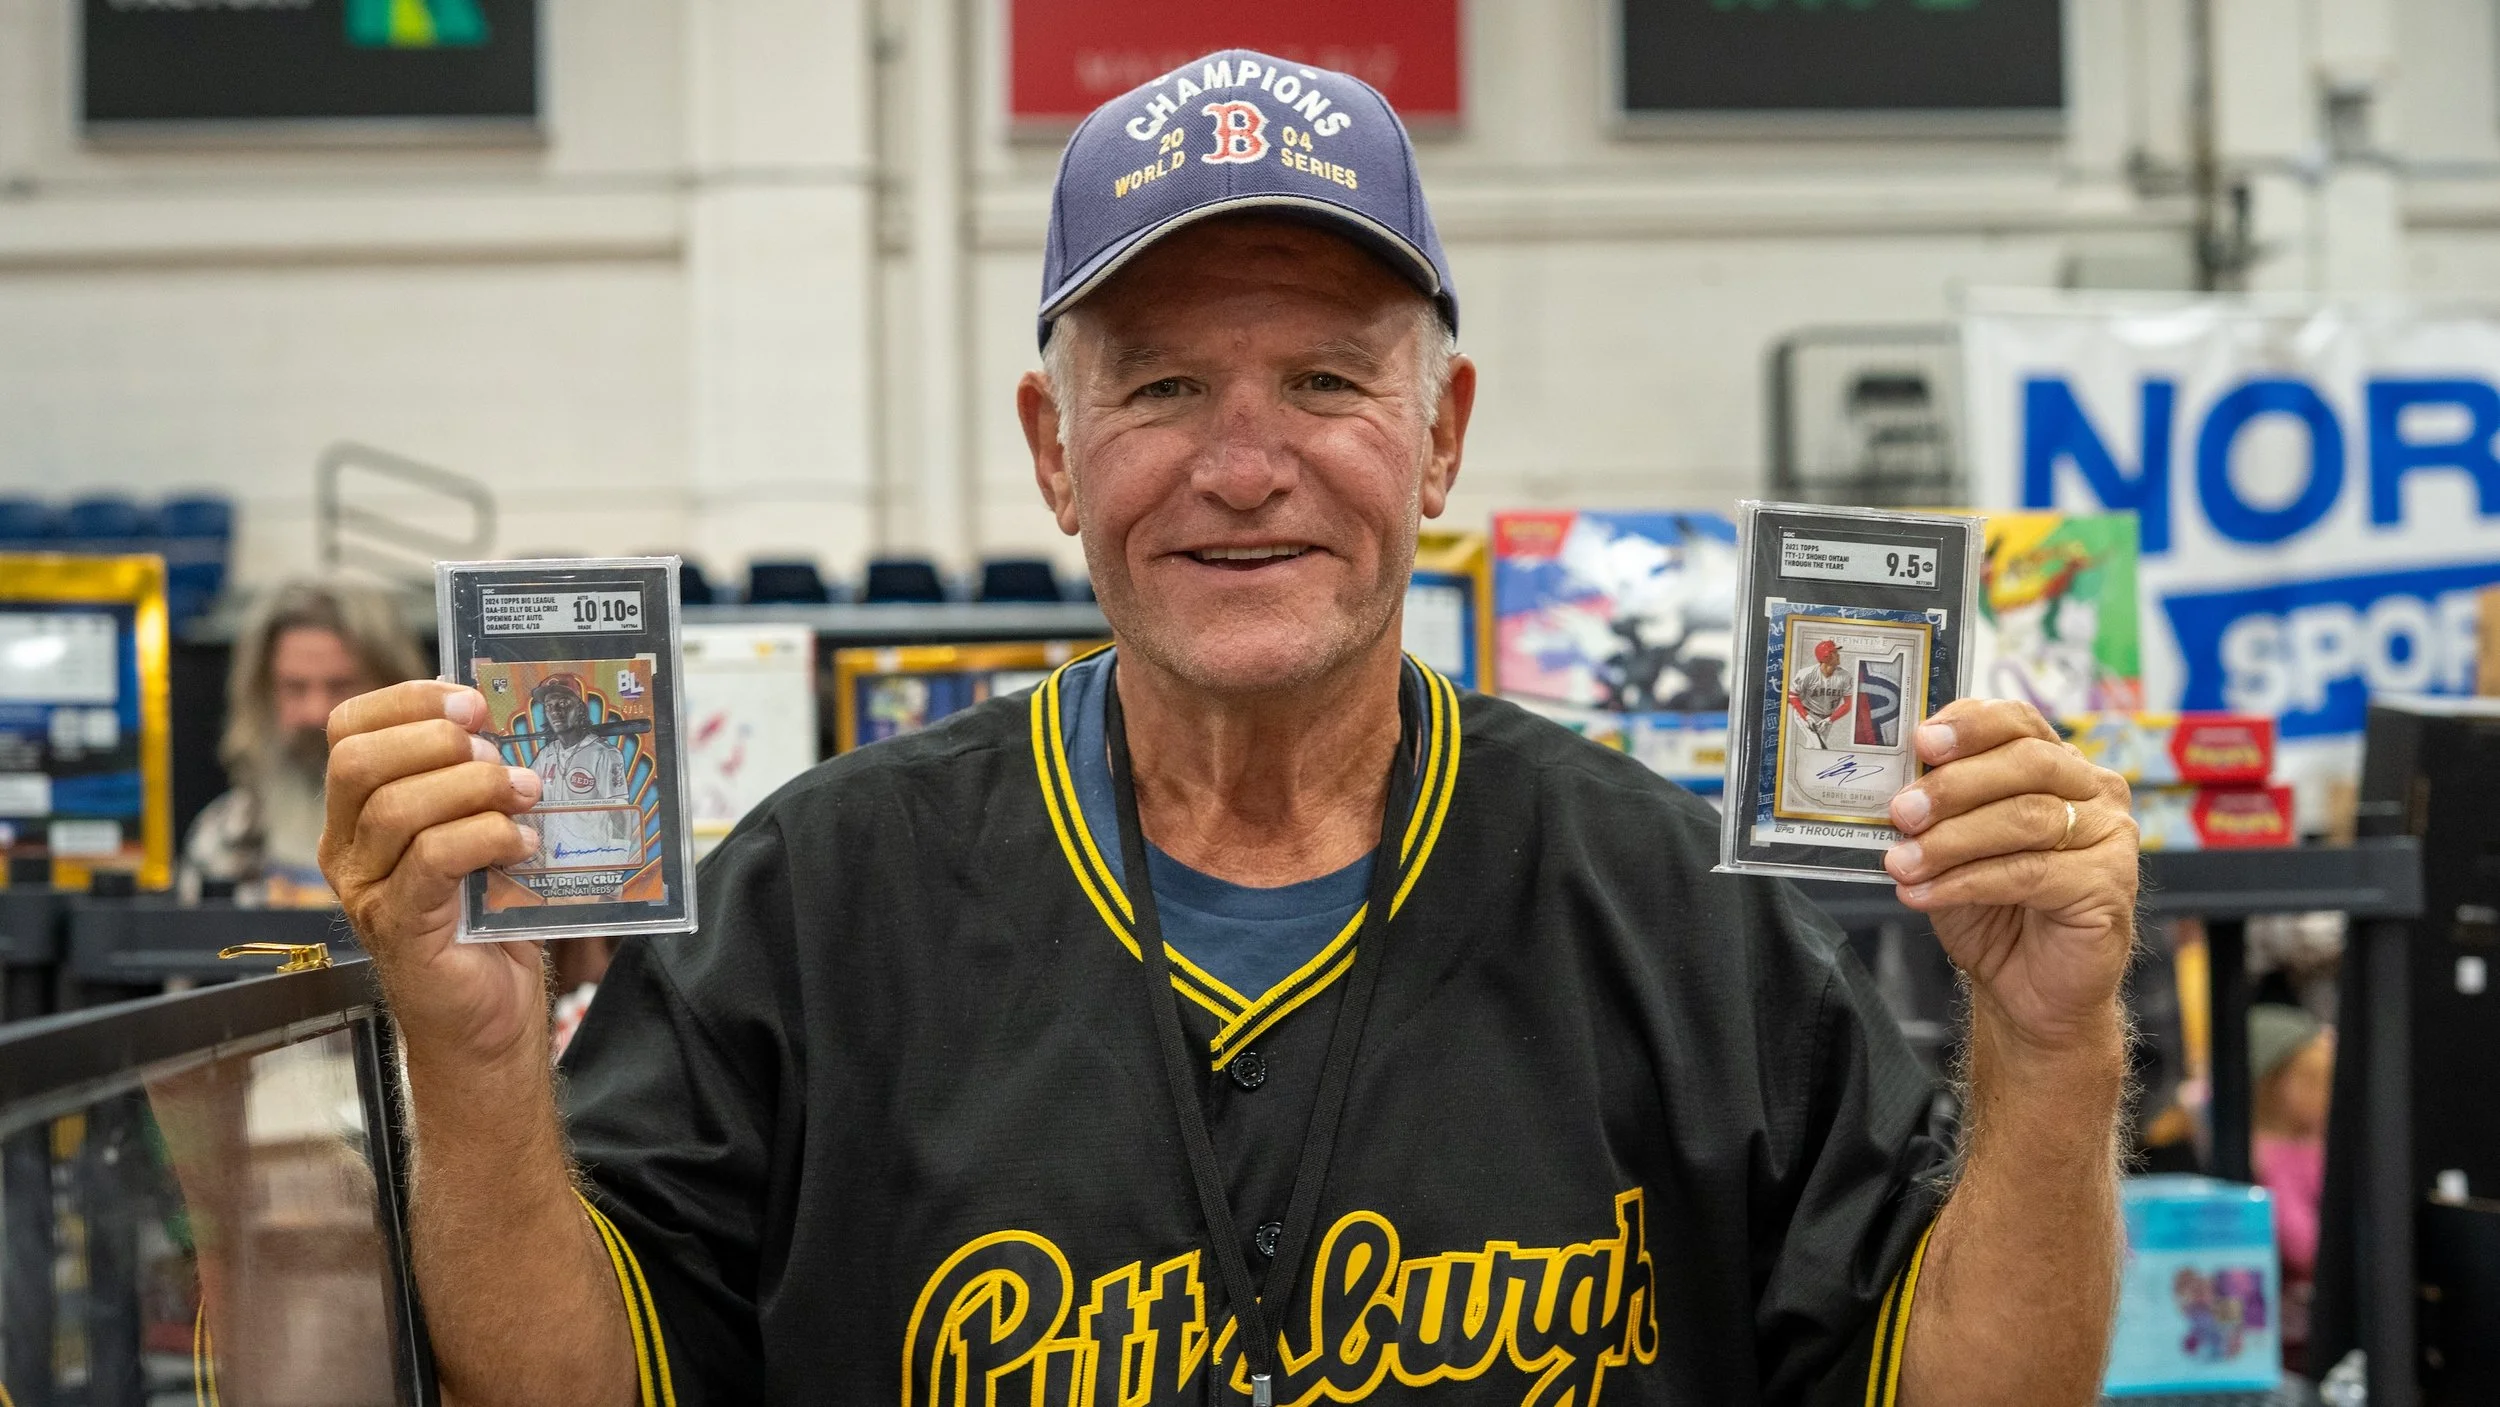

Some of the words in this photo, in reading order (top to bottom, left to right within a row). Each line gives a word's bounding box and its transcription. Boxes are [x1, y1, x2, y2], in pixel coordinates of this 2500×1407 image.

[1125, 60, 1352, 141] CHAMPIONS
[1158, 127, 1185, 155] 20
[1282, 126, 1313, 153] 04
[1200, 100, 1271, 165] B
[1114, 150, 1185, 199] WORLD
[1280, 148, 1358, 190] SERIES
[1800, 544, 1820, 552] TOPPS
[1784, 560, 1812, 568] THROUGH
[1886, 552, 1920, 578] 9.5
[573, 600, 597, 622] 10
[602, 600, 626, 622] 10
[572, 777, 595, 786] REDS
[1799, 826, 1854, 838] THROUGH
[529, 878, 554, 887] ELLY
[592, 874, 623, 884] CRUZ
[542, 888, 589, 897] CINCINNATI
